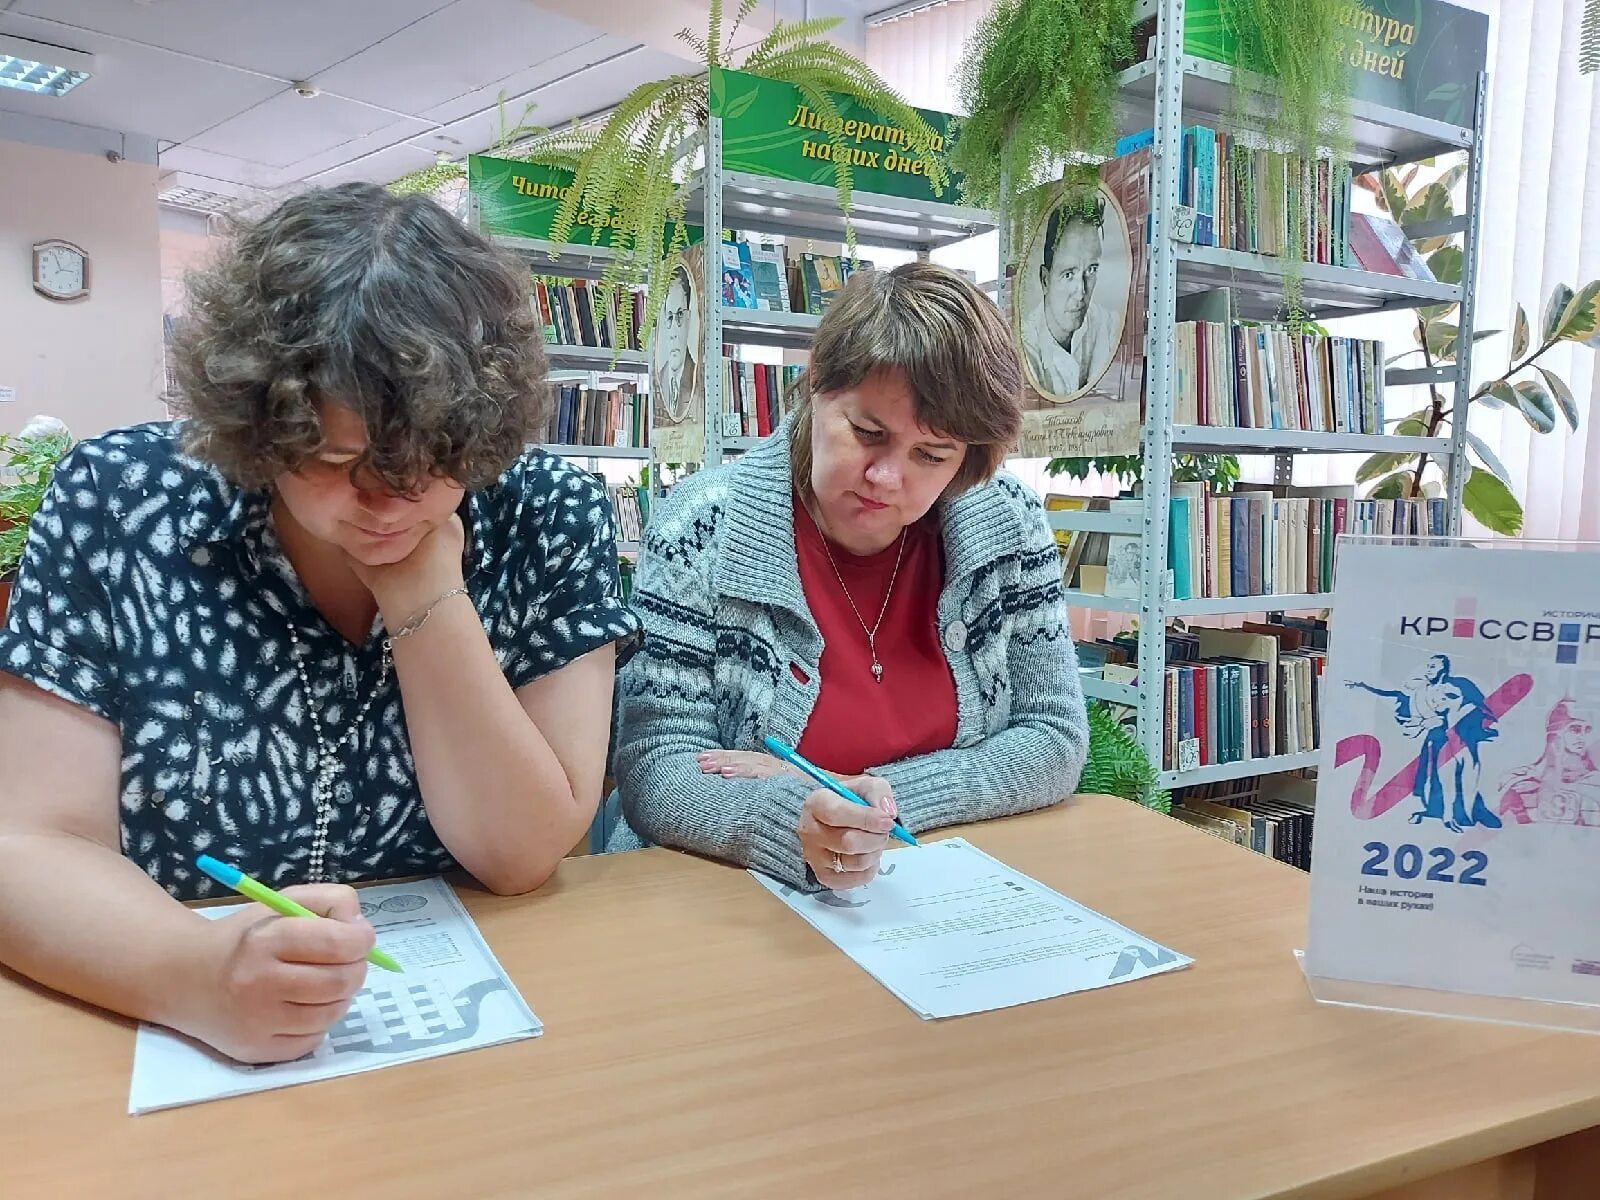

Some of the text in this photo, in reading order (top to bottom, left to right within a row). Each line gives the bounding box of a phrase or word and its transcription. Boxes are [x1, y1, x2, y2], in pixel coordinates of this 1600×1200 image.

[1349, 39, 1407, 80] дней
[787, 104, 945, 153] Лиератуа
[1360, 841, 1489, 886] 2022
[1358, 885, 1434, 899] Наша история
